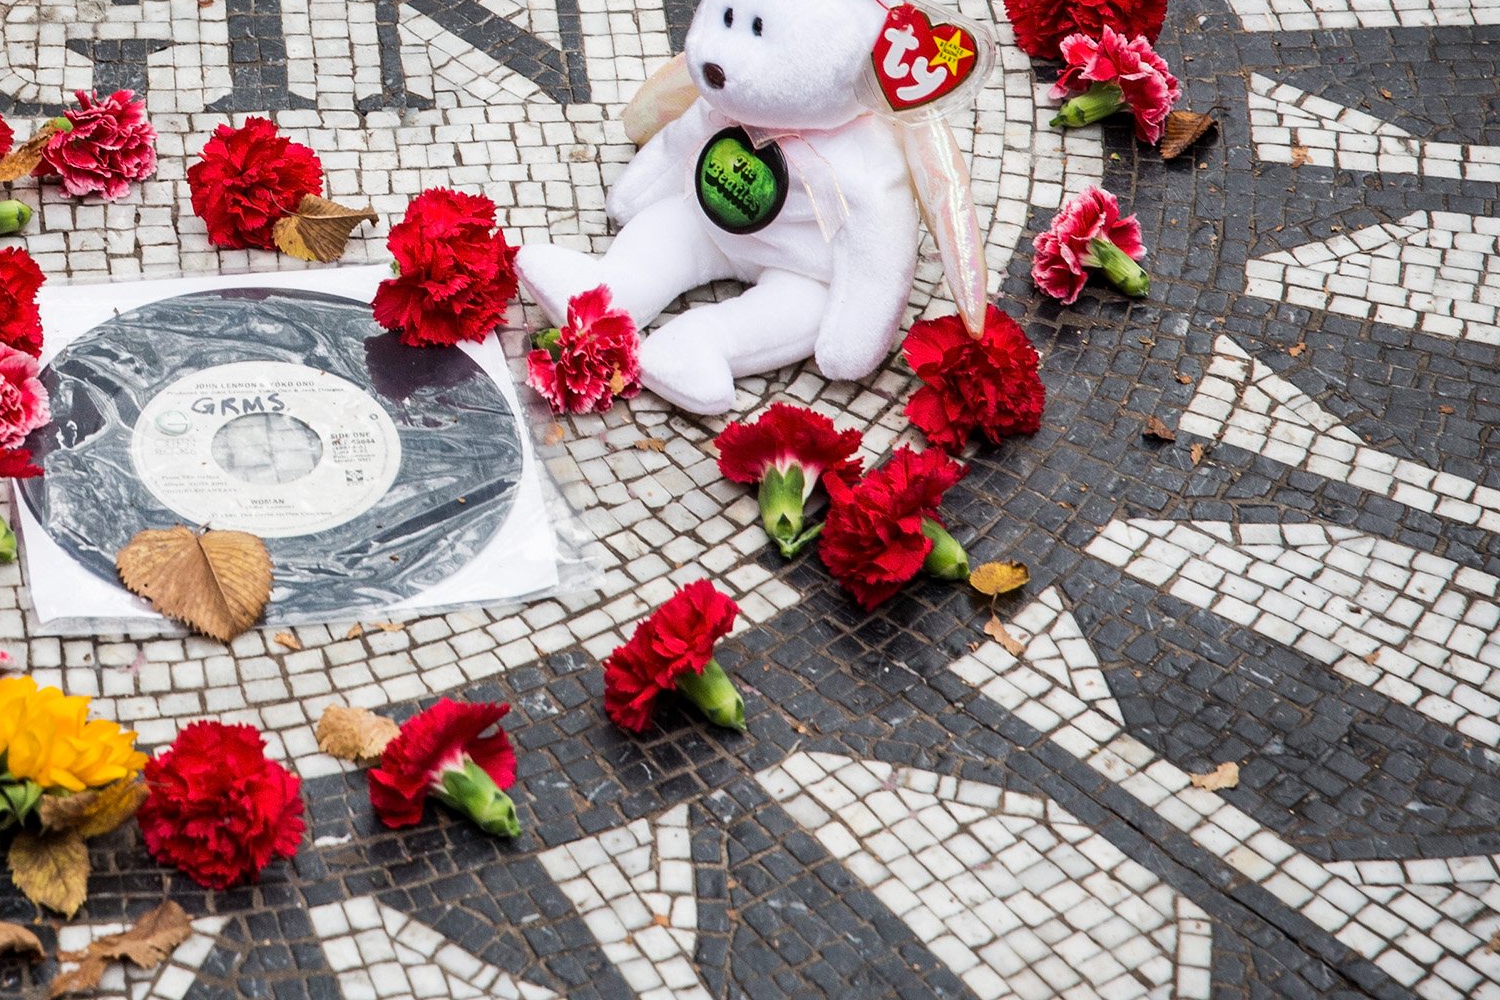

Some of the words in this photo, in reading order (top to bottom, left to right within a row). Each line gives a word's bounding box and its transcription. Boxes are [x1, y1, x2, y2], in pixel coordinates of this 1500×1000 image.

[883, 24, 948, 101] ty
[705, 159, 760, 216] Beatles
[733, 154, 757, 182] The
